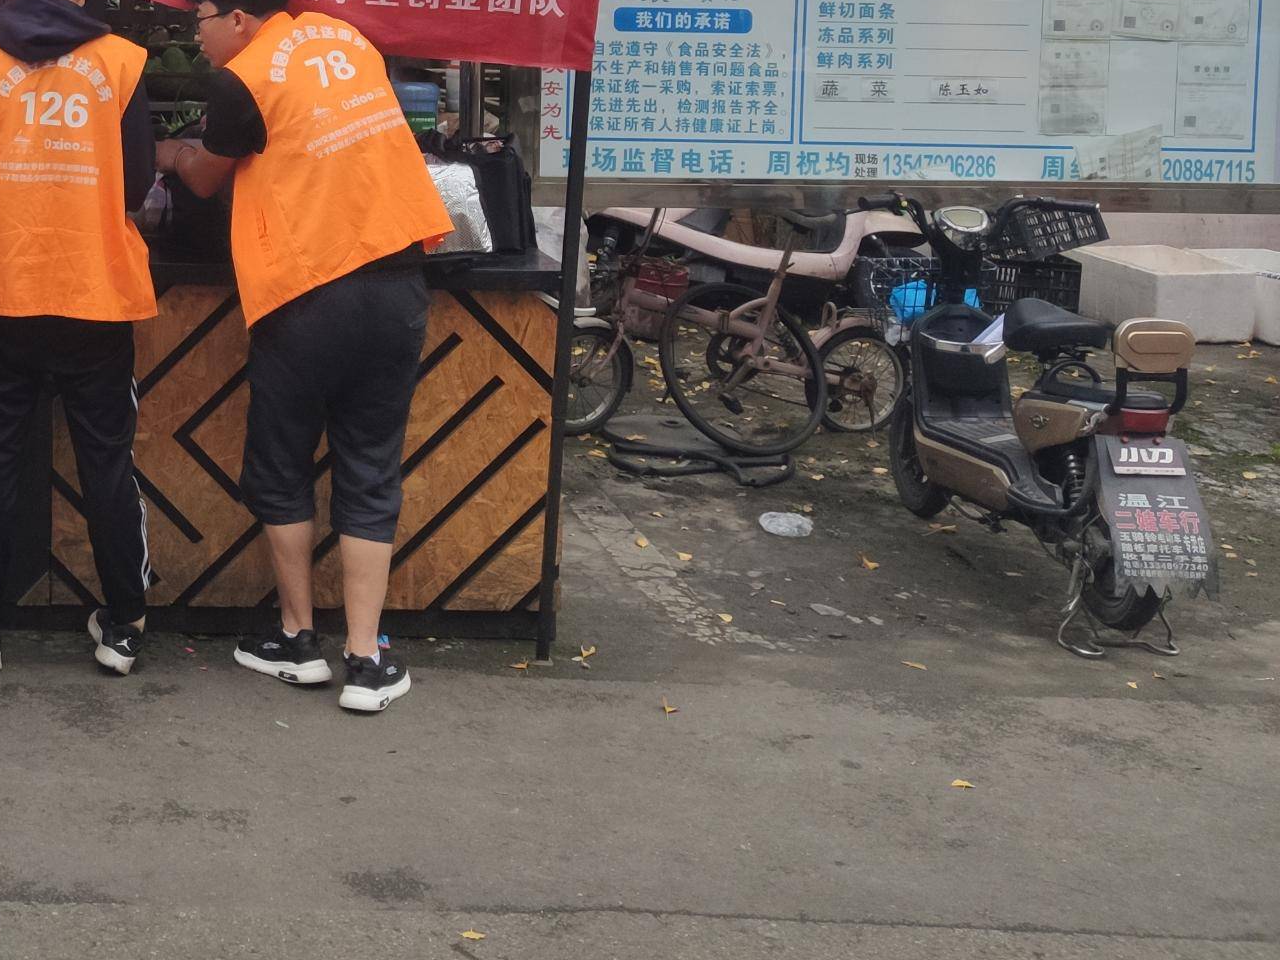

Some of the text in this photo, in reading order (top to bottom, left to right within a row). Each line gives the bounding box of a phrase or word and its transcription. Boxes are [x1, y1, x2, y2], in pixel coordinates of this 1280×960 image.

[818, 1, 895, 19] 鲜切面条
[635, 10, 732, 30] 我们的承诺
[817, 27, 894, 45] 冻品系列
[304, 50, 356, 88] 78
[816, 52, 893, 69] 鲜肉系列
[20, 92, 89, 128] 126
[1162, 159, 1256, 182] 208847115
[1118, 493, 1188, 509] 温江
